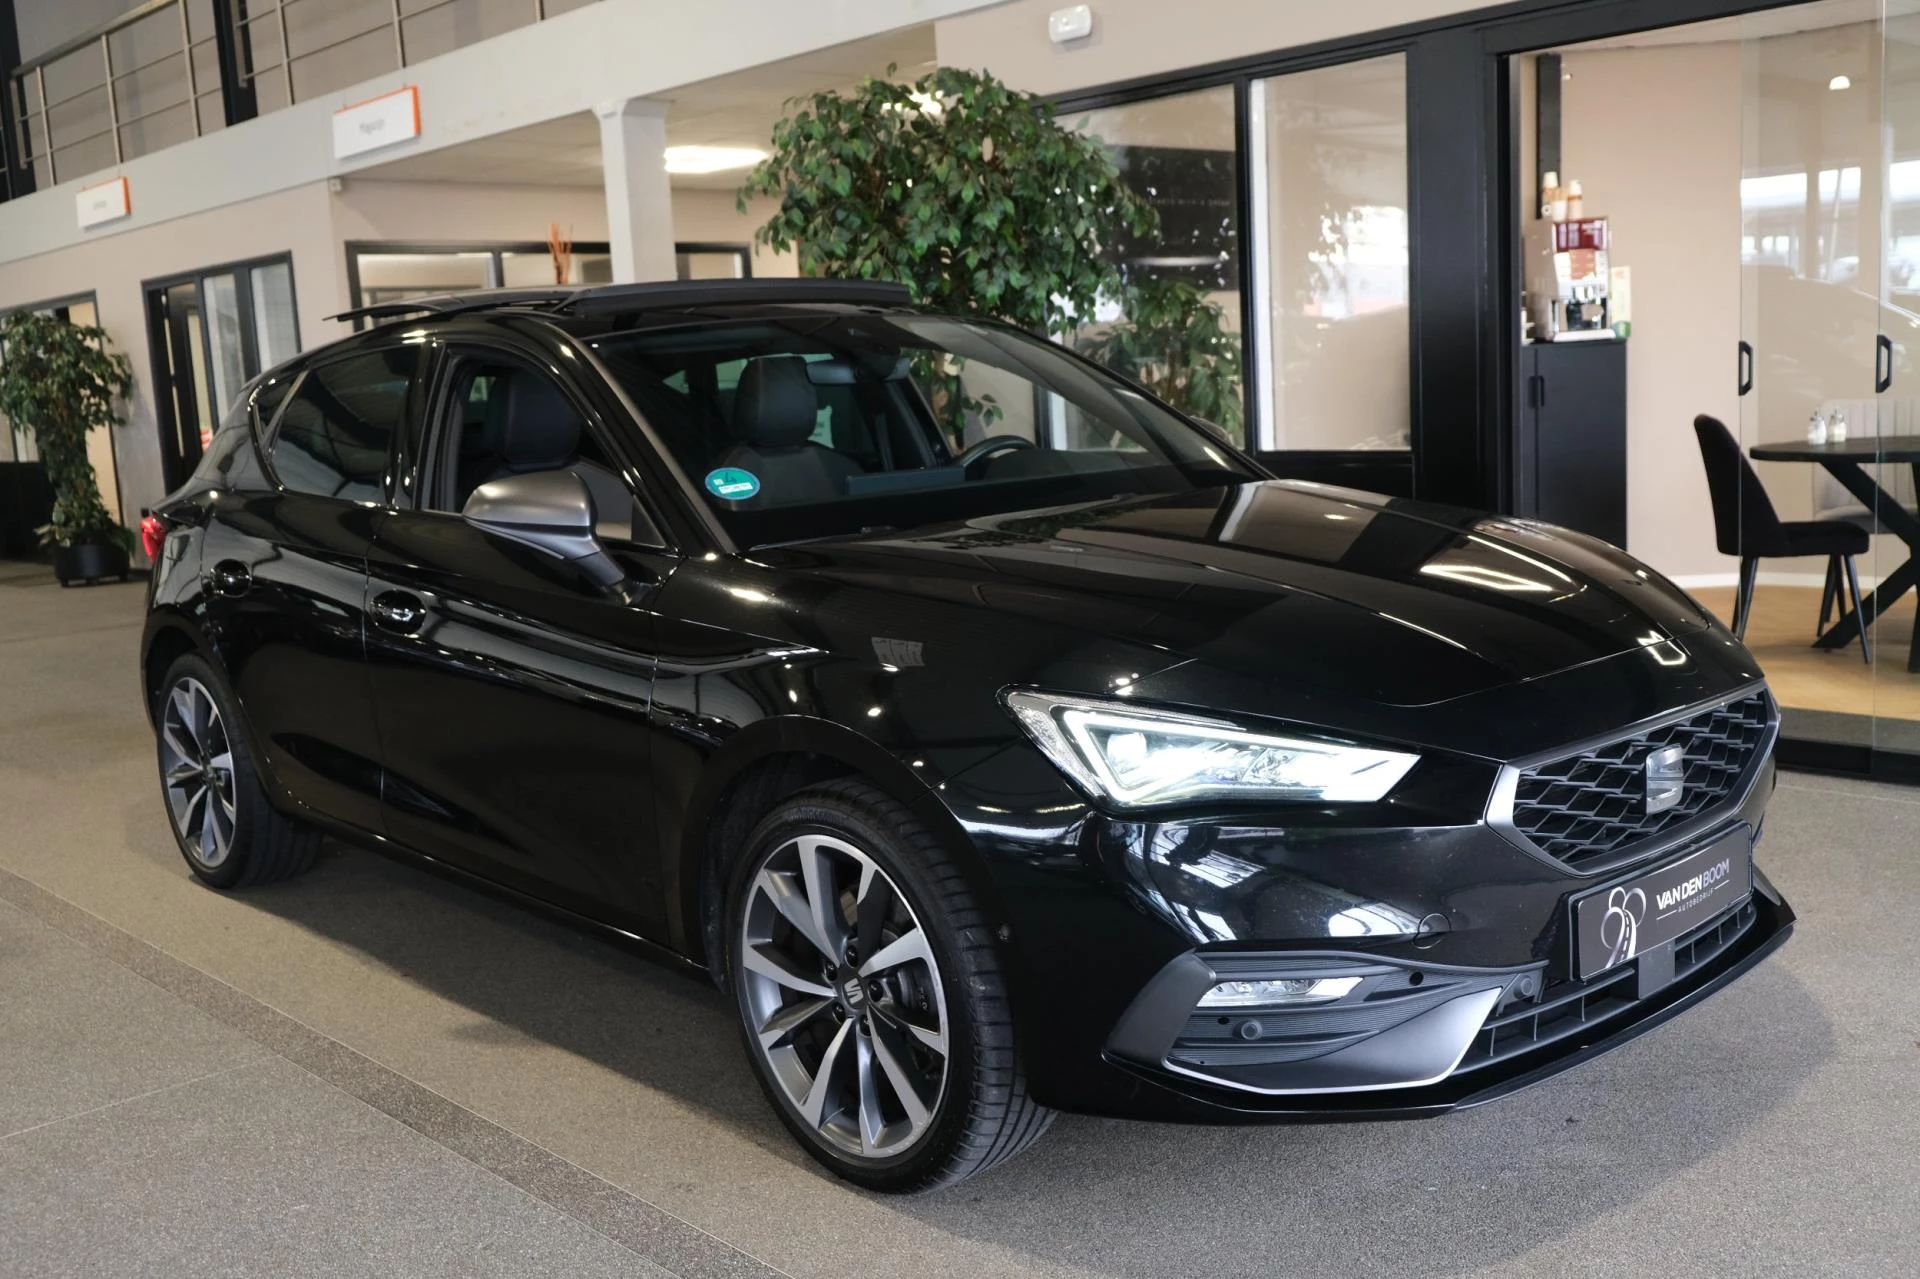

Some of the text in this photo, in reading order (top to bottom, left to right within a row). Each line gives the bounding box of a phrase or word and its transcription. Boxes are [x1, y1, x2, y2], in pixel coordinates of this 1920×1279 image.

[1656, 858, 1730, 910] VAN DEN BOOM
